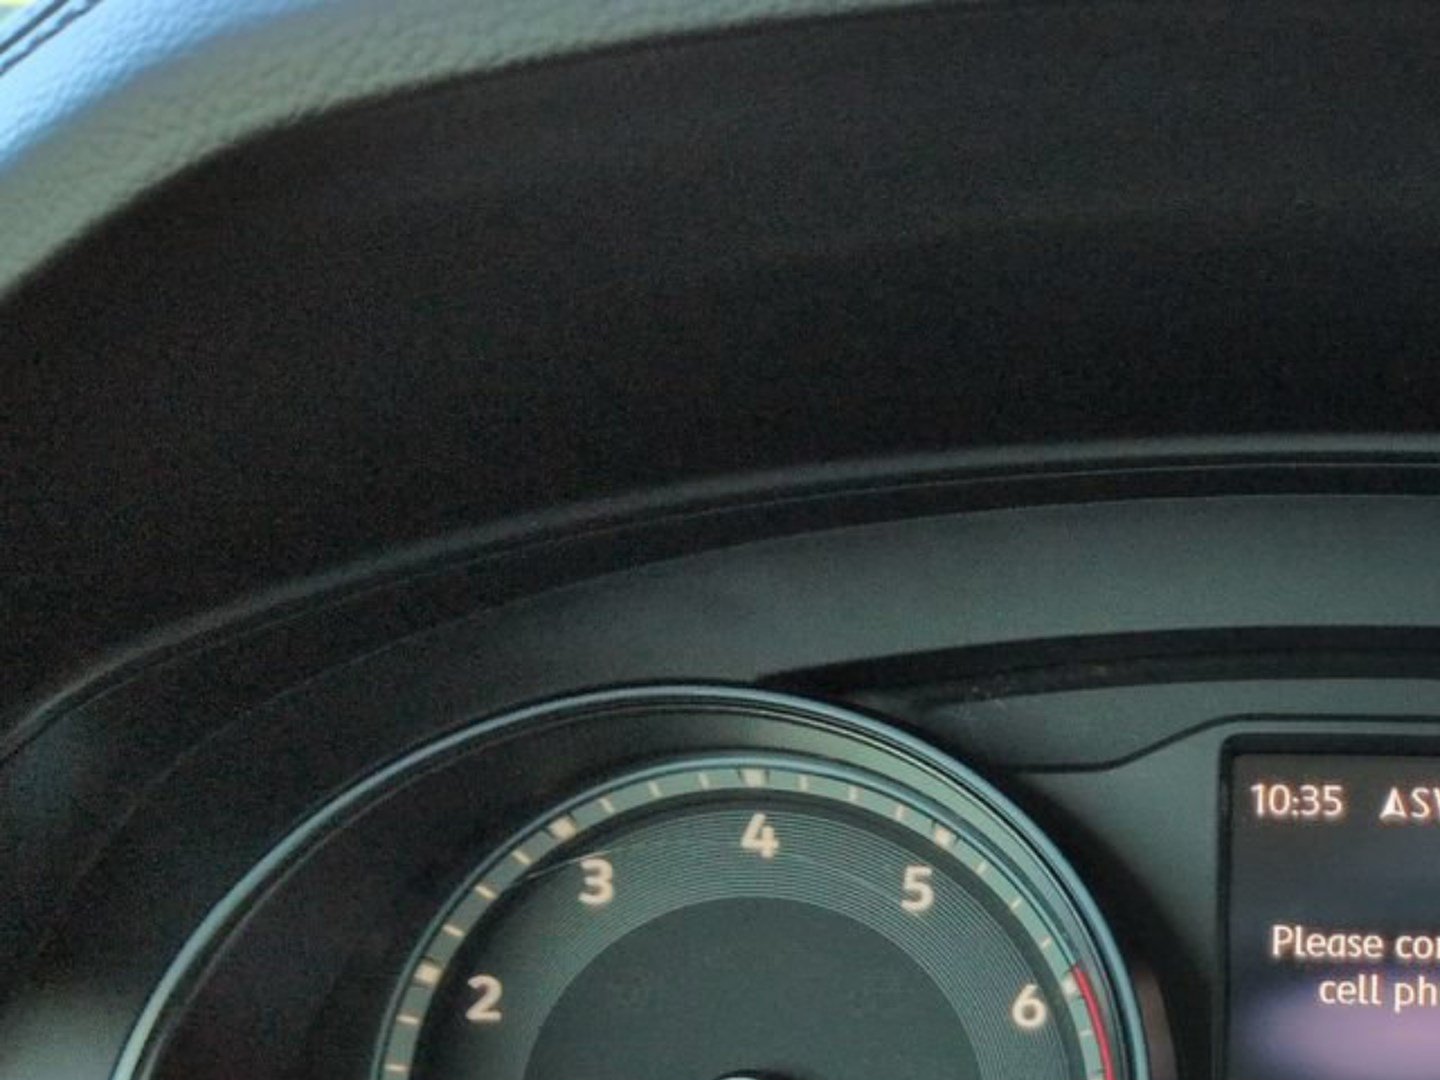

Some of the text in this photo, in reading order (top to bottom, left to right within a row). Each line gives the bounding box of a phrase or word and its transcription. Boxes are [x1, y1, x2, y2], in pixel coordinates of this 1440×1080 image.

[1251, 784, 1344, 817] 10:35
[740, 812, 779, 859] 4
[579, 860, 614, 905] 3
[901, 866, 935, 913] 5
[1271, 925, 1384, 960] Please
[466, 976, 502, 1021] 2
[1011, 983, 1047, 1029] 6
[1318, 975, 1382, 1006] cell
